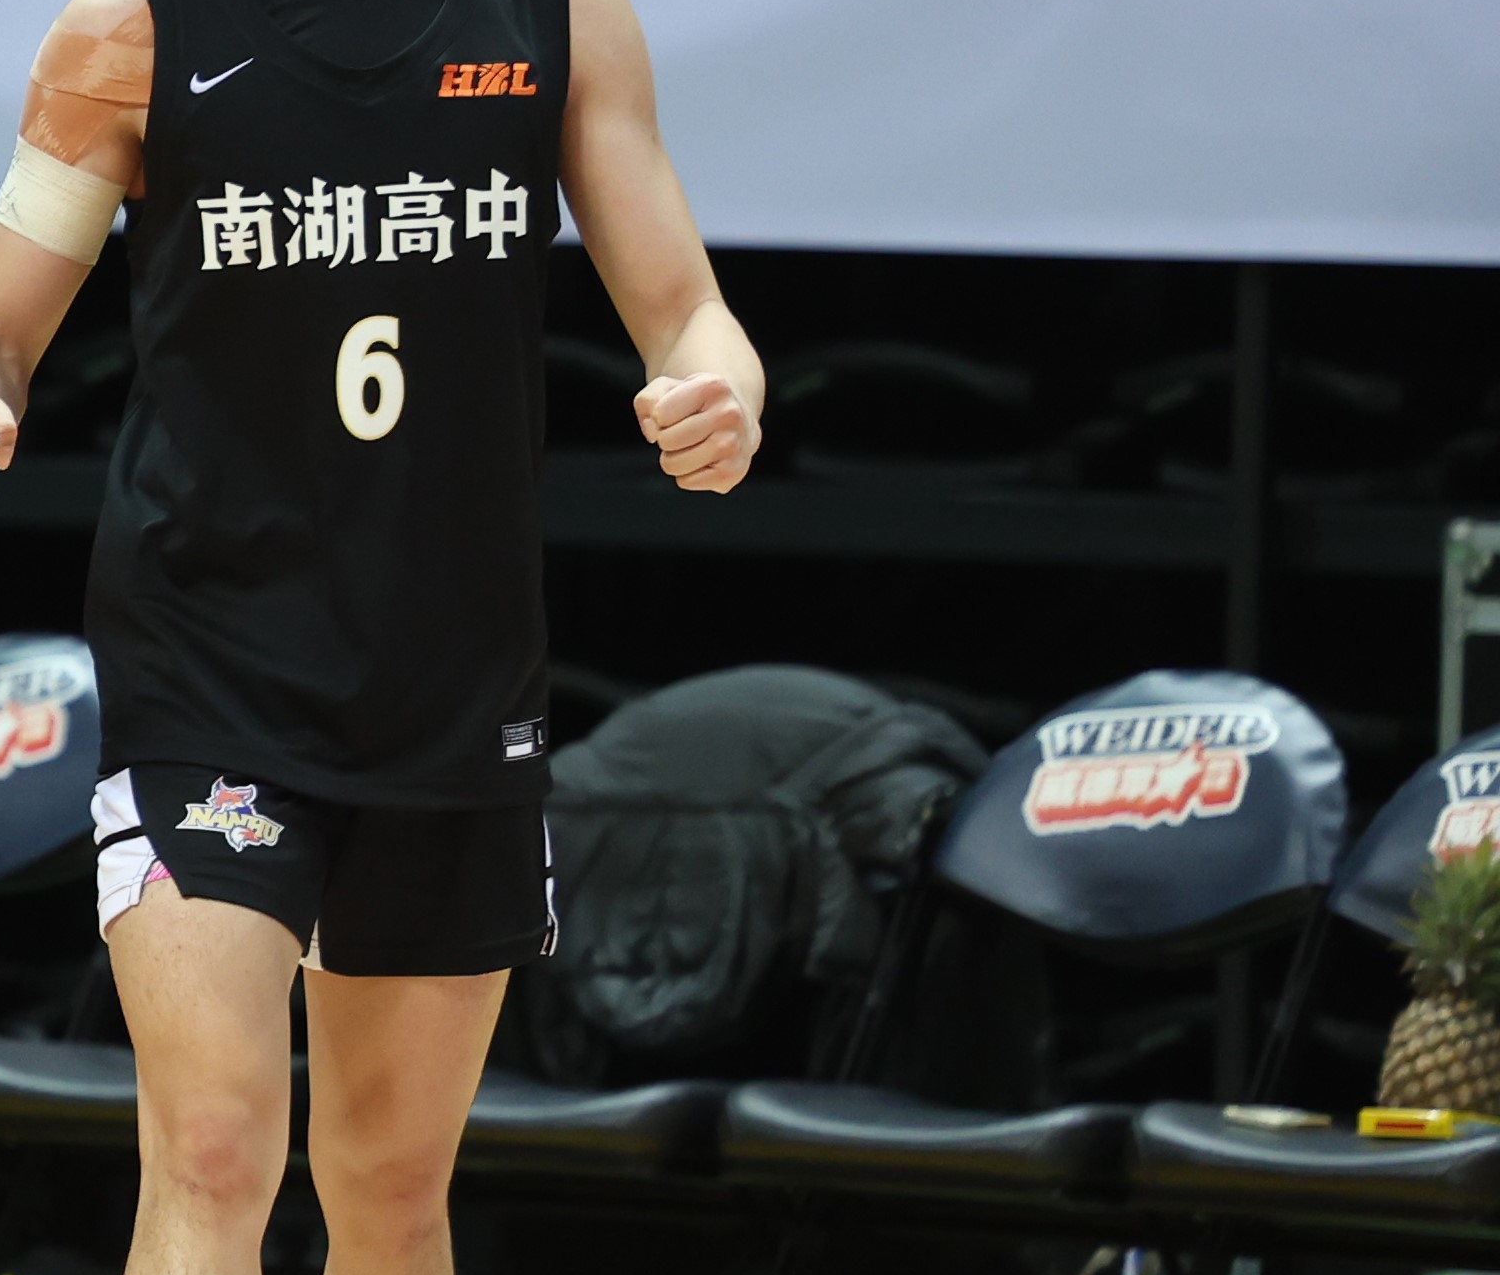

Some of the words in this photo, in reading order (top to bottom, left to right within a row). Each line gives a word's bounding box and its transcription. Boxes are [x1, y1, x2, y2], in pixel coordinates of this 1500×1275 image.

[438, 63, 537, 98] HBL
[197, 168, 529, 271] 南湖高中
[336, 315, 405, 441] 6
[1052, 714, 1272, 758] WEIDER
[188, 806, 281, 843] NANHU
